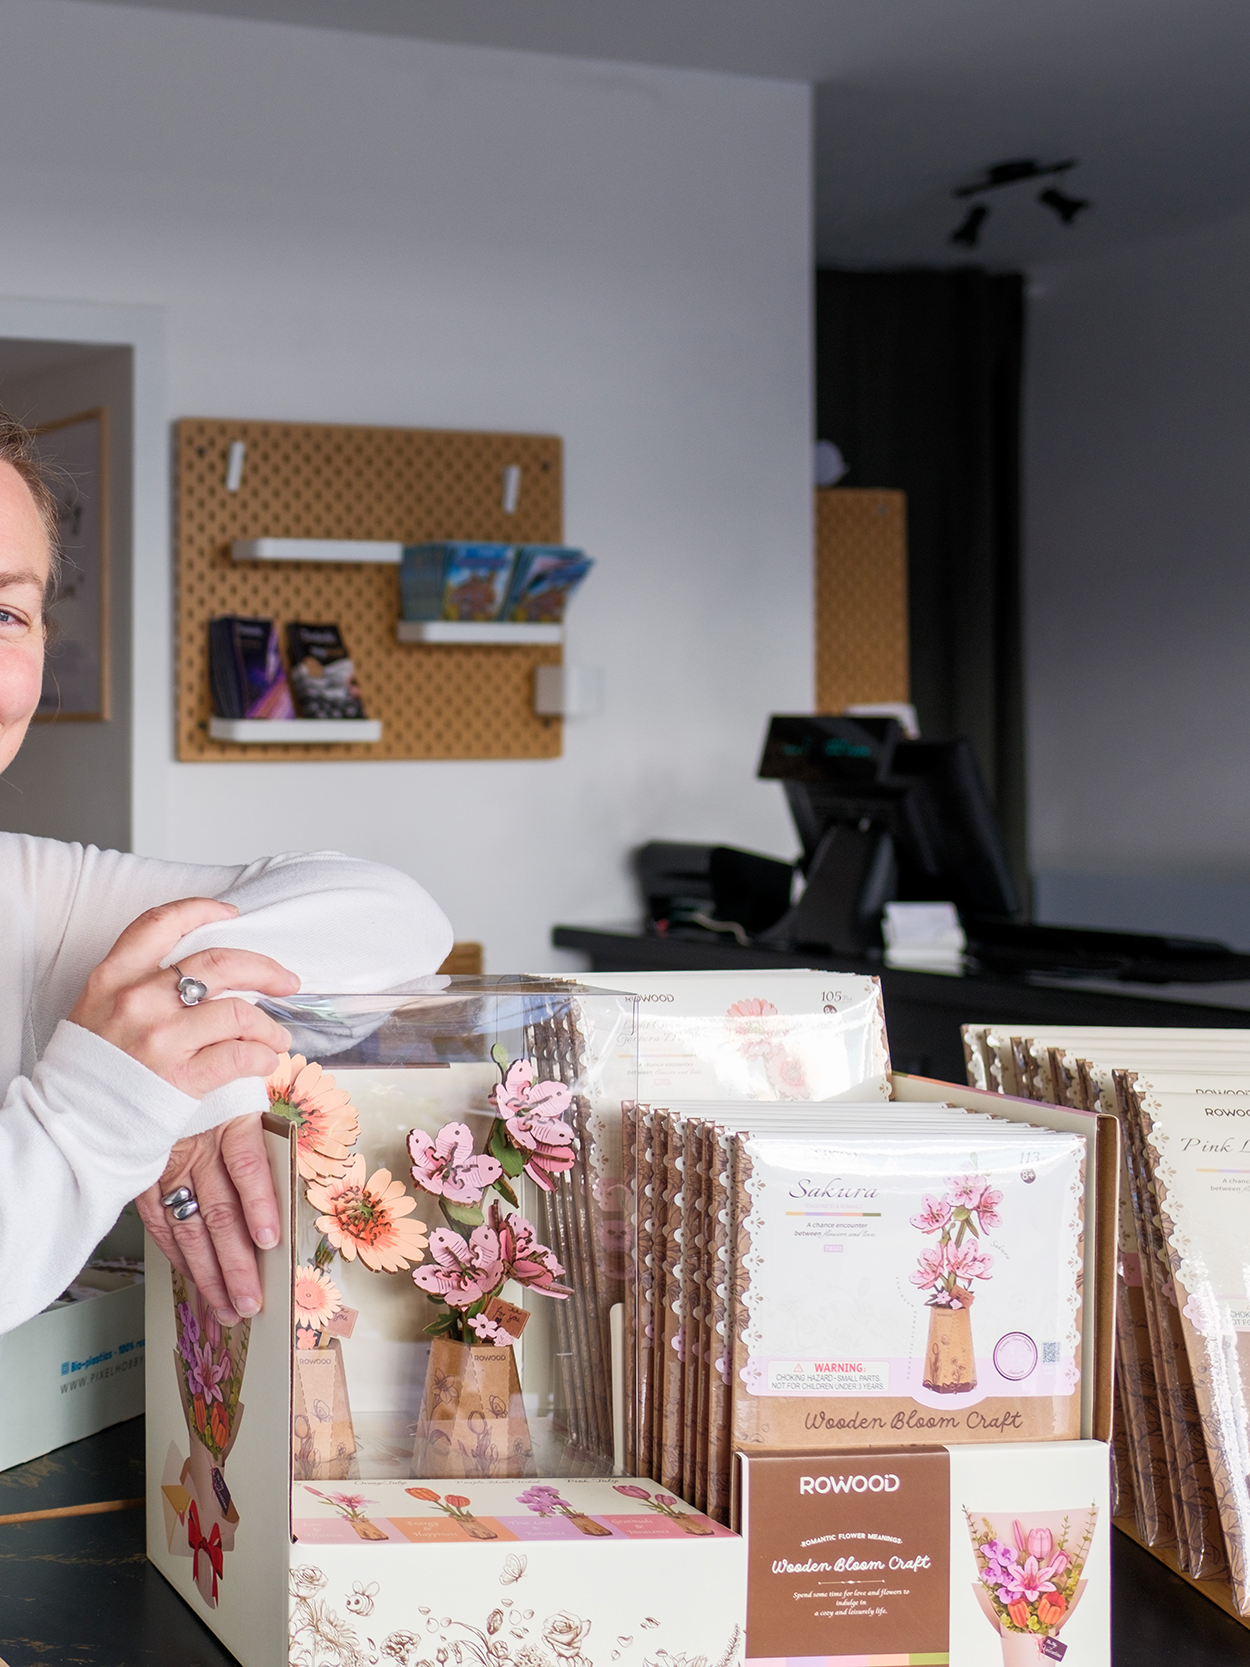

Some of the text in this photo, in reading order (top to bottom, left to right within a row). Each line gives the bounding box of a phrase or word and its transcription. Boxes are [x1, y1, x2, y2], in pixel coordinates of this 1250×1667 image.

[821, 991, 842, 1002] 105
[1180, 1137, 1235, 1153] Pink
[788, 1177, 880, 1199] Sakura
[474, 1354, 506, 1362] ROWOOD
[814, 1363, 866, 1373] WARNING:
[775, 1373, 806, 1382] CHOKING
[807, 1374, 833, 1382] HAZARD
[837, 1375, 858, 1383] SMALL
[771, 1382, 786, 1390] NOT
[787, 1382, 801, 1390] FOR
[804, 1410, 1023, 1433] Wooden Bloom Craft
[800, 1474, 900, 1495] ROWOOD
[405, 1520, 439, 1528] Energy
[838, 1532, 866, 1540] FLOWER
[771, 1555, 931, 1574] Wooden Bloom Craft
[793, 1590, 813, 1600] Spend
[842, 1589, 853, 1599] for
[854, 1589, 867, 1597] love
[867, 1588, 881, 1596] and
[879, 1587, 902, 1598] flowers
[836, 1598, 859, 1608] indulge
[834, 1608, 848, 1616] and
[848, 1607, 875, 1617] leisurely
[875, 1607, 888, 1616] life.
